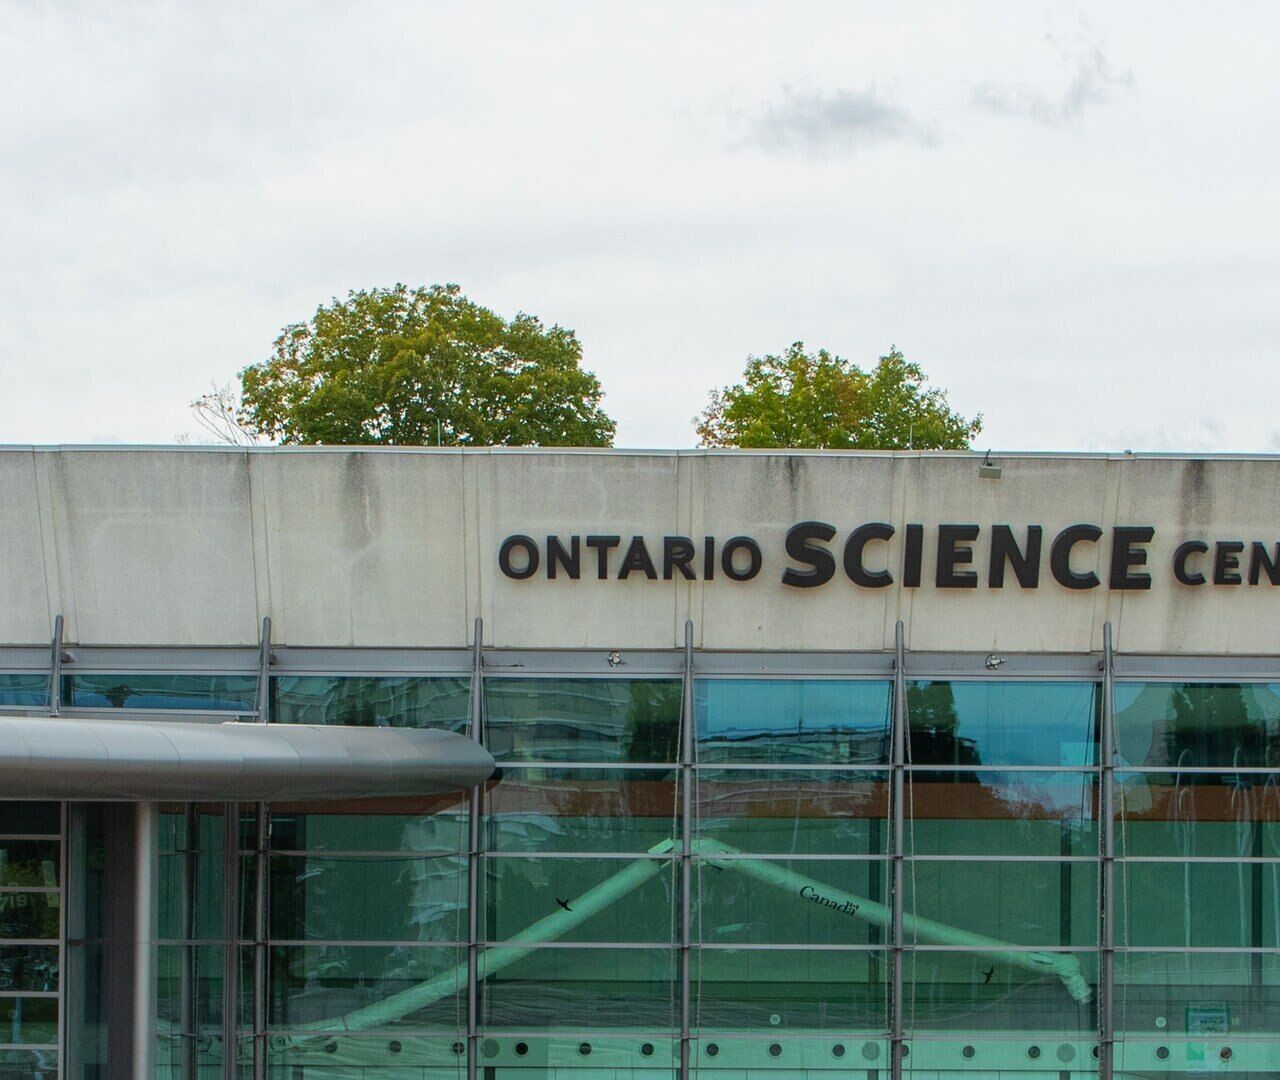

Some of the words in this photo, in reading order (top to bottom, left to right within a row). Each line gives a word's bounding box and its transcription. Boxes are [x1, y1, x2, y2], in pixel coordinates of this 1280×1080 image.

[498, 534, 763, 582] ONTARIO
[781, 521, 1155, 591] SCIENCE
[799, 885, 857, 916] Canada
